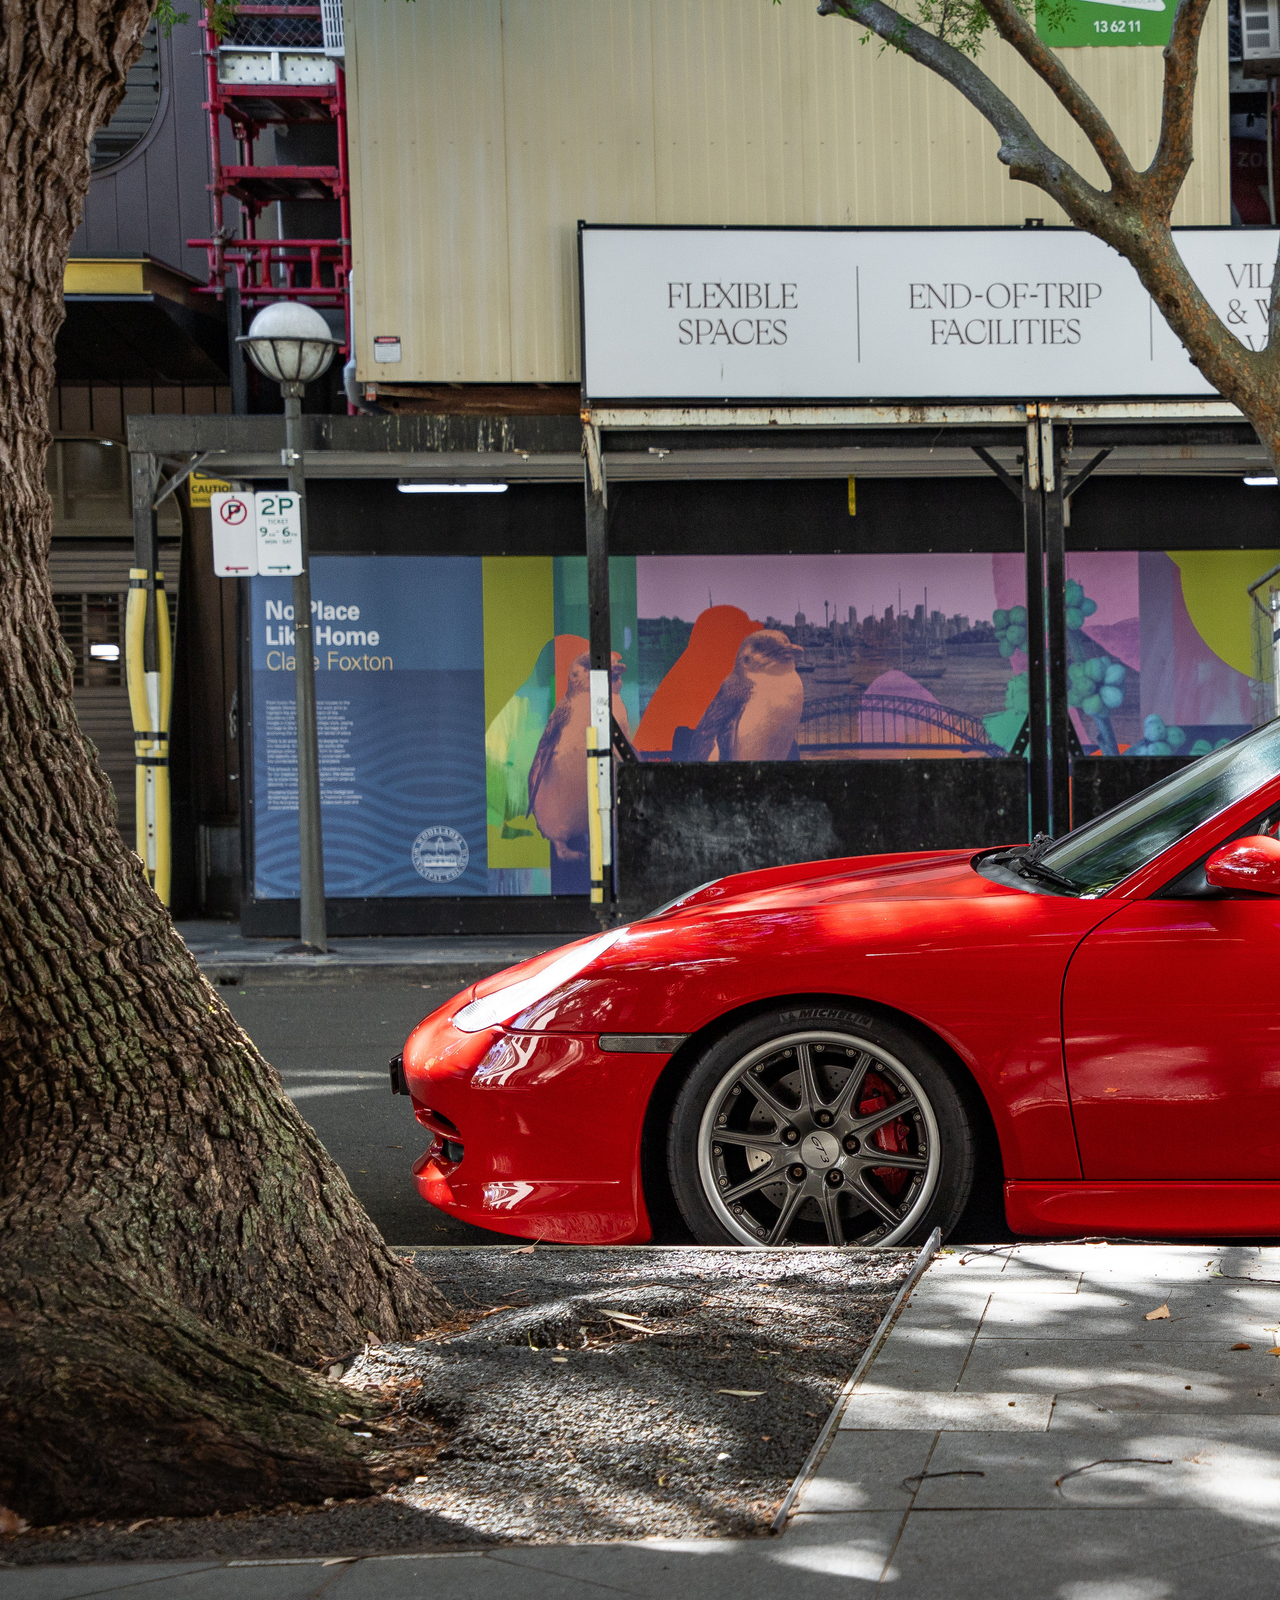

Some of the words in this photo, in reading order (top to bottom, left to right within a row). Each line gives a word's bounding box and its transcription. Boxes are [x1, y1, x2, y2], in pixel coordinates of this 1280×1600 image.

[667, 282, 799, 309] FLEXIBLE
[908, 282, 1103, 310] END-OF-TRIP
[1226, 298, 1249, 325] &
[678, 318, 788, 346] SPACES
[930, 318, 1082, 345] FACILITIES
[191, 484, 230, 494] CAUTIO
[261, 498, 293, 516] 2P
[265, 600, 295, 621] No
[266, 625, 295, 646] Lik
[315, 625, 380, 646] Home
[266, 650, 320, 671] Clae
[327, 650, 393, 671] Foxton
[799, 1009, 874, 1029] MICHELIN
